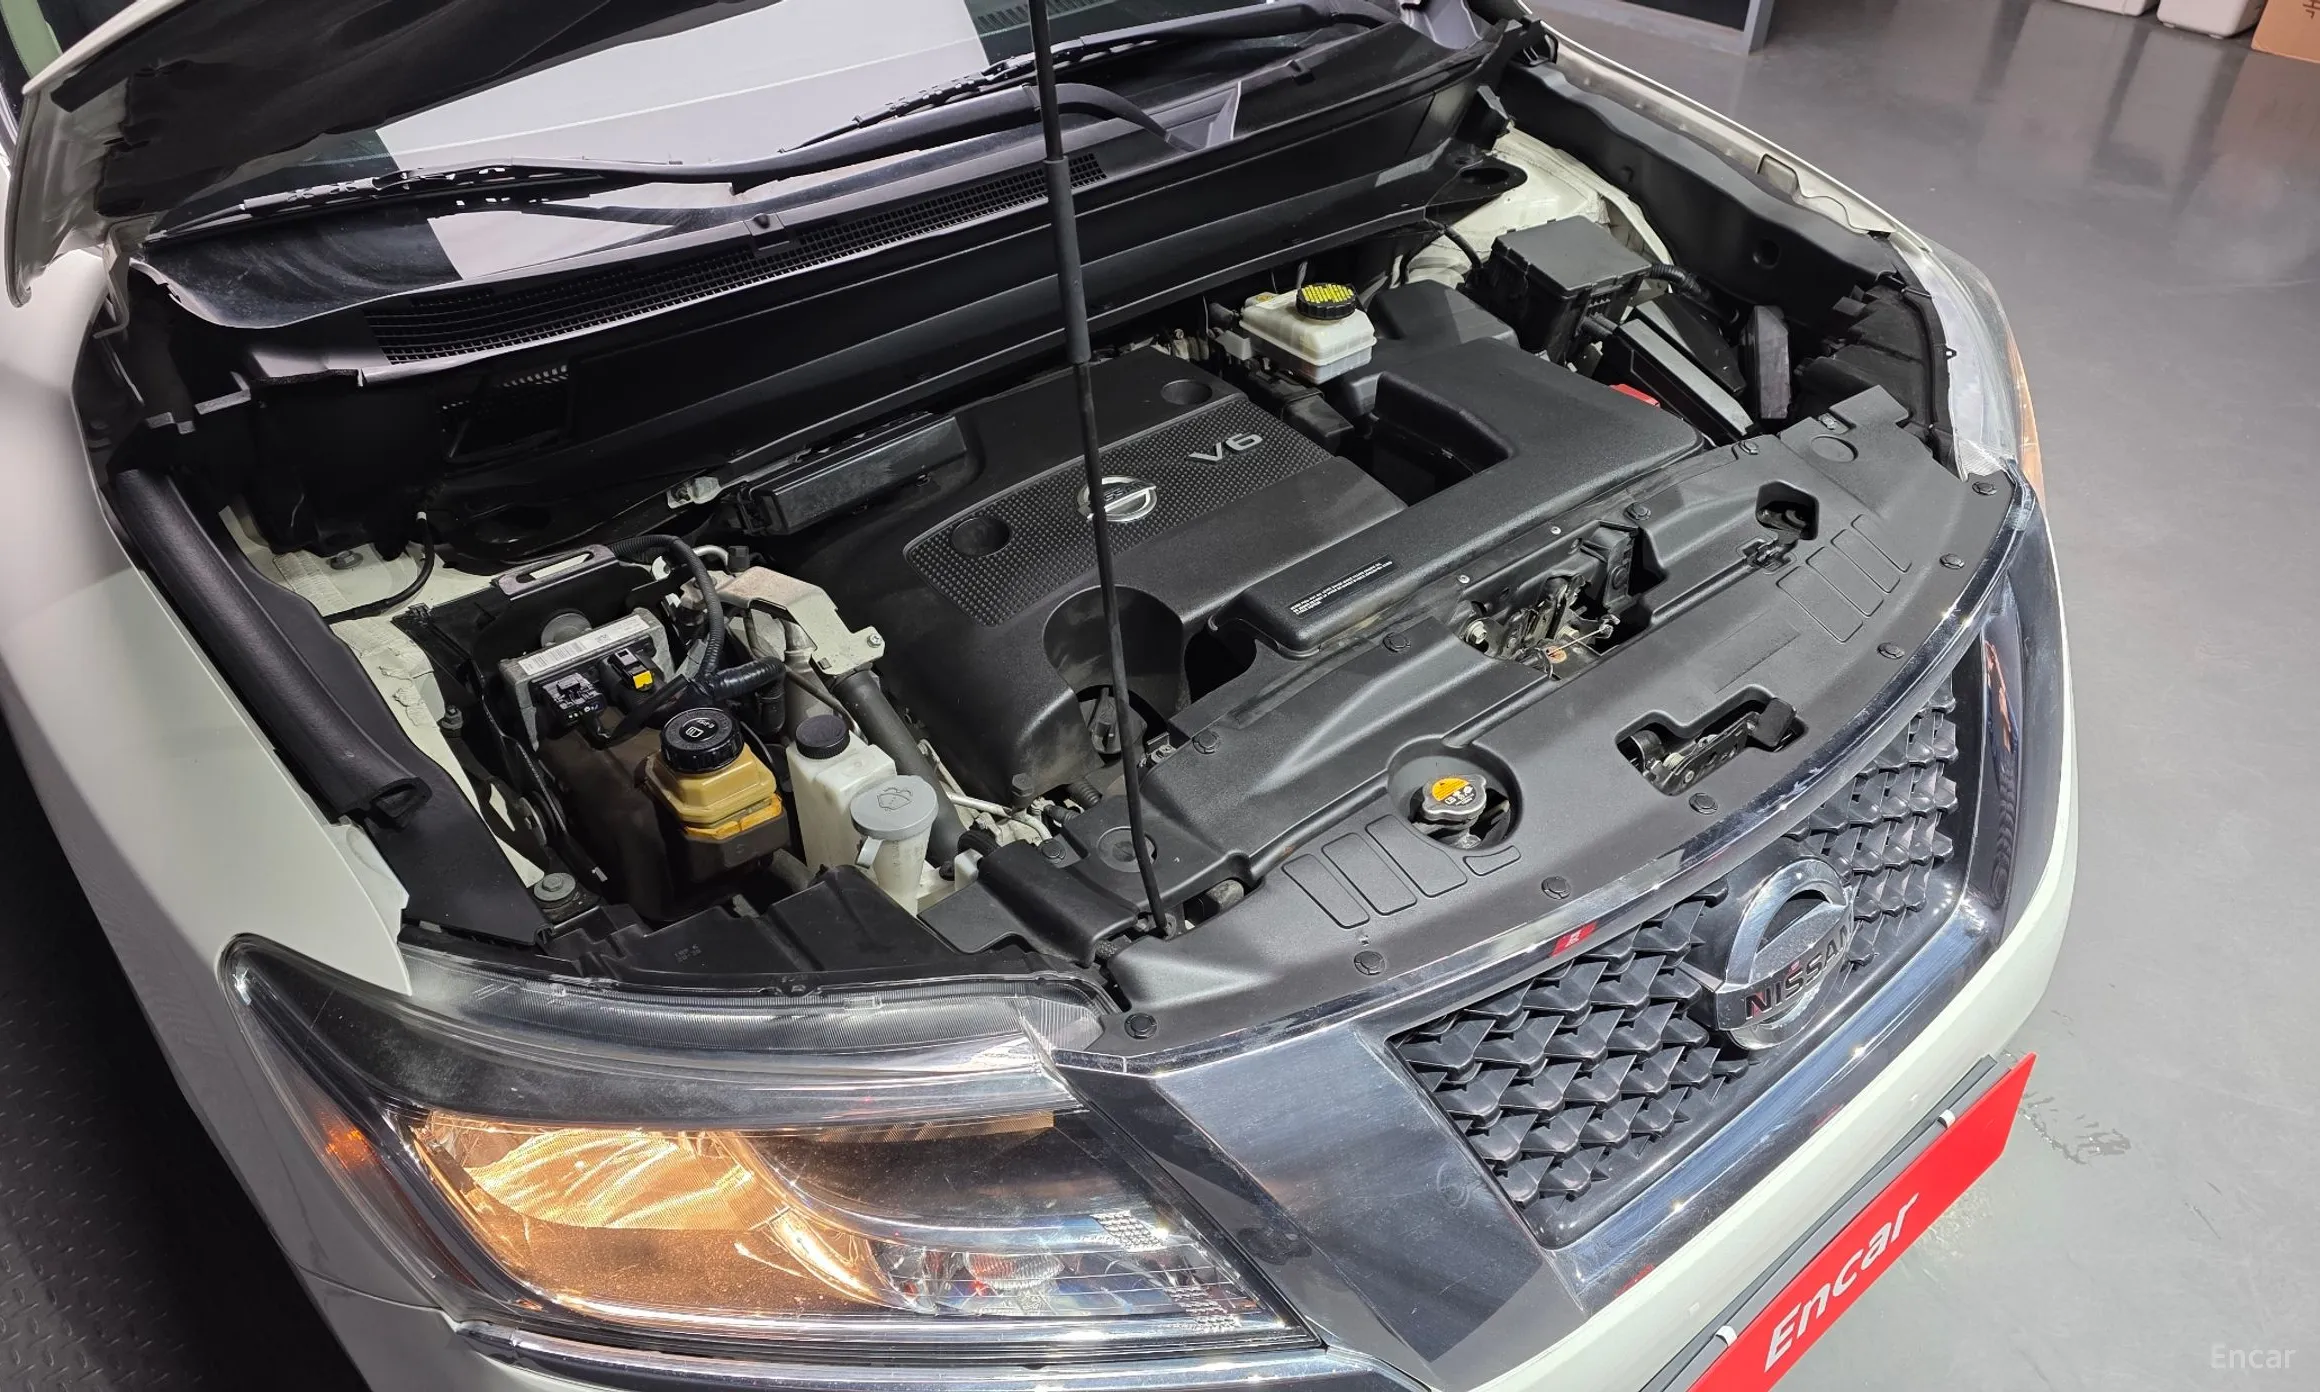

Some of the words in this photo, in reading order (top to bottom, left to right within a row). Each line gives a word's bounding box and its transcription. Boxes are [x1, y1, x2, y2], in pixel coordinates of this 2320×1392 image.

[1188, 433, 1264, 462] V6
[1744, 924, 1849, 1020] NISSAN
[1764, 1192, 1920, 1373] Encar
